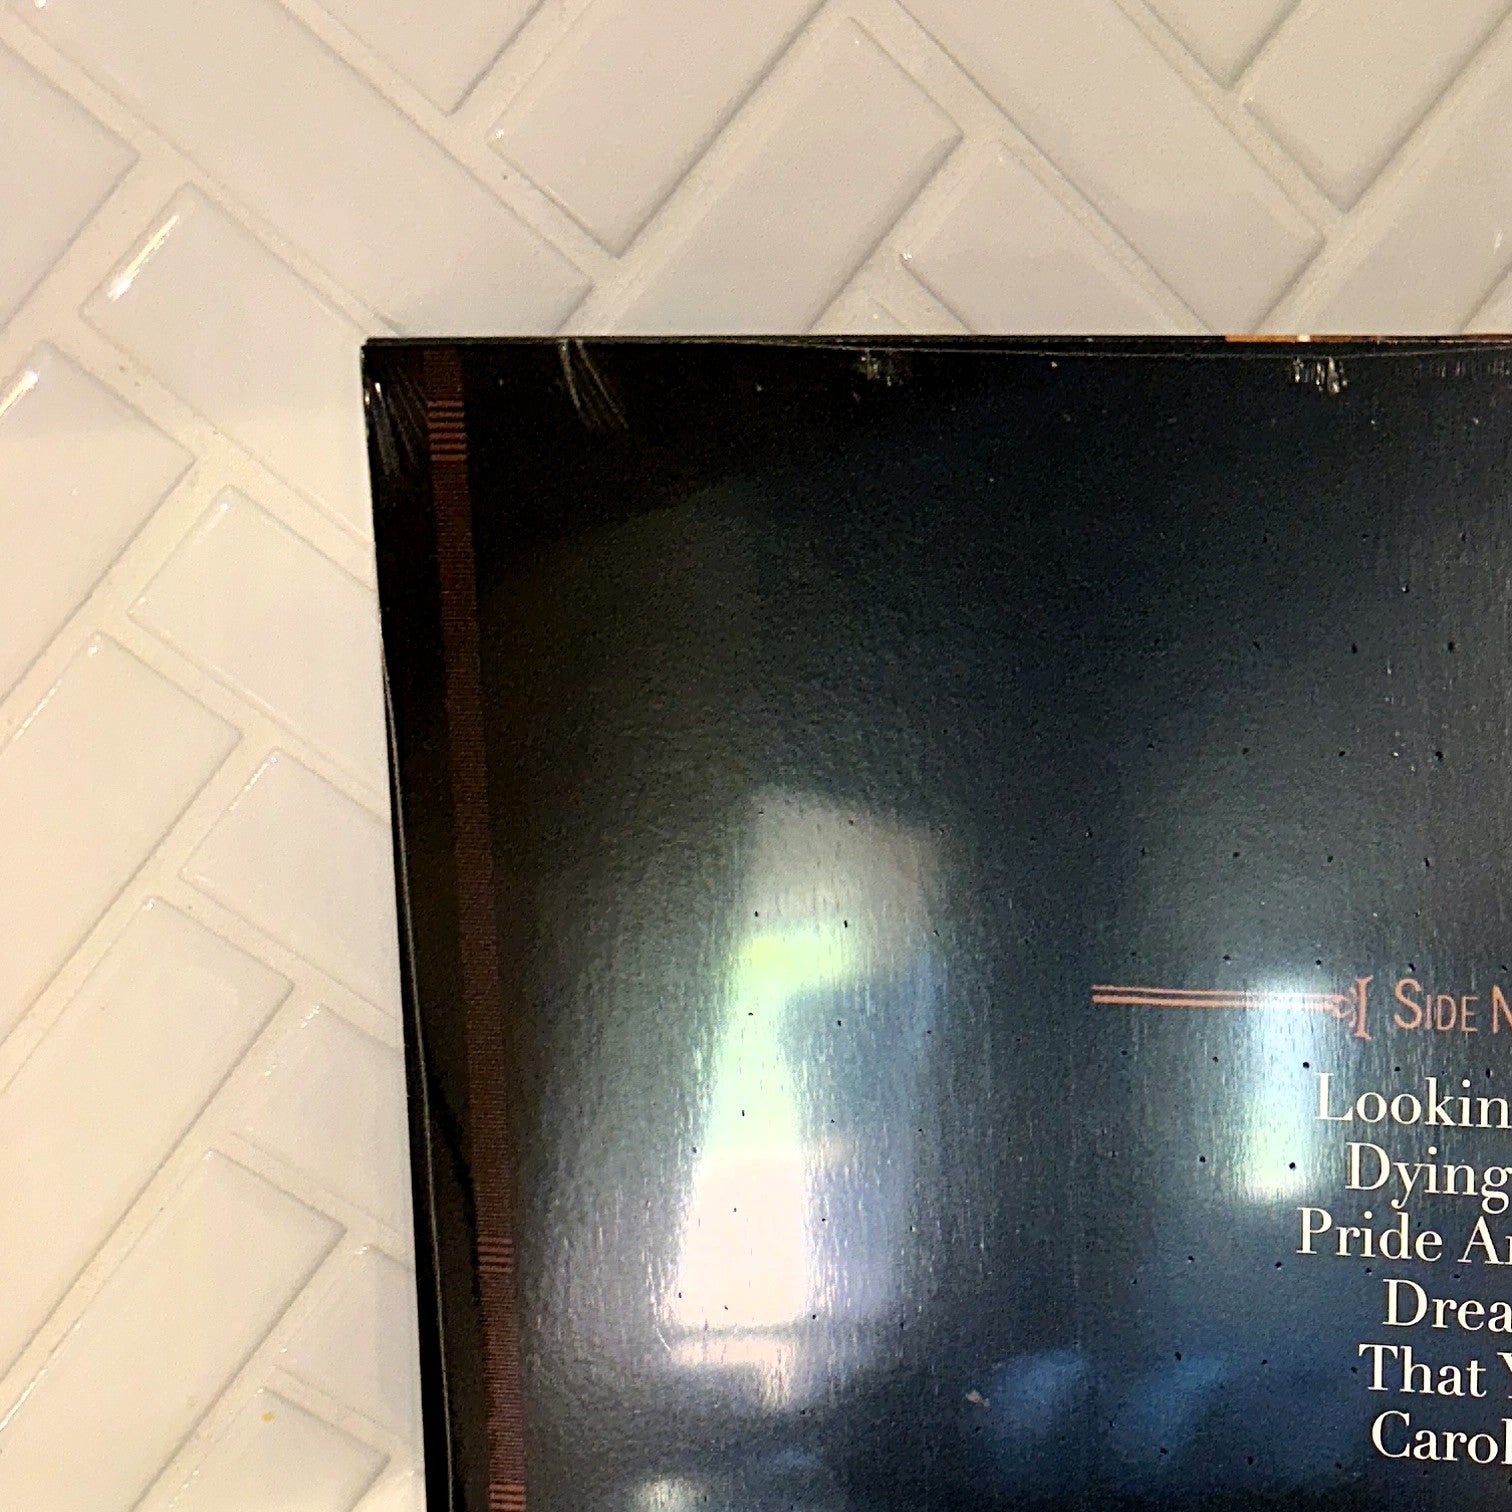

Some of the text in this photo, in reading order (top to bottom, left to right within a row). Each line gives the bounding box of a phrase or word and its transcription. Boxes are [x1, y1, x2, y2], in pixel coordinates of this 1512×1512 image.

[1393, 978, 1478, 1036] SIDE
[1345, 1143, 1512, 1215] Dying
[1296, 1208, 1442, 1263] Pride
[1359, 1344, 1487, 1400] That
